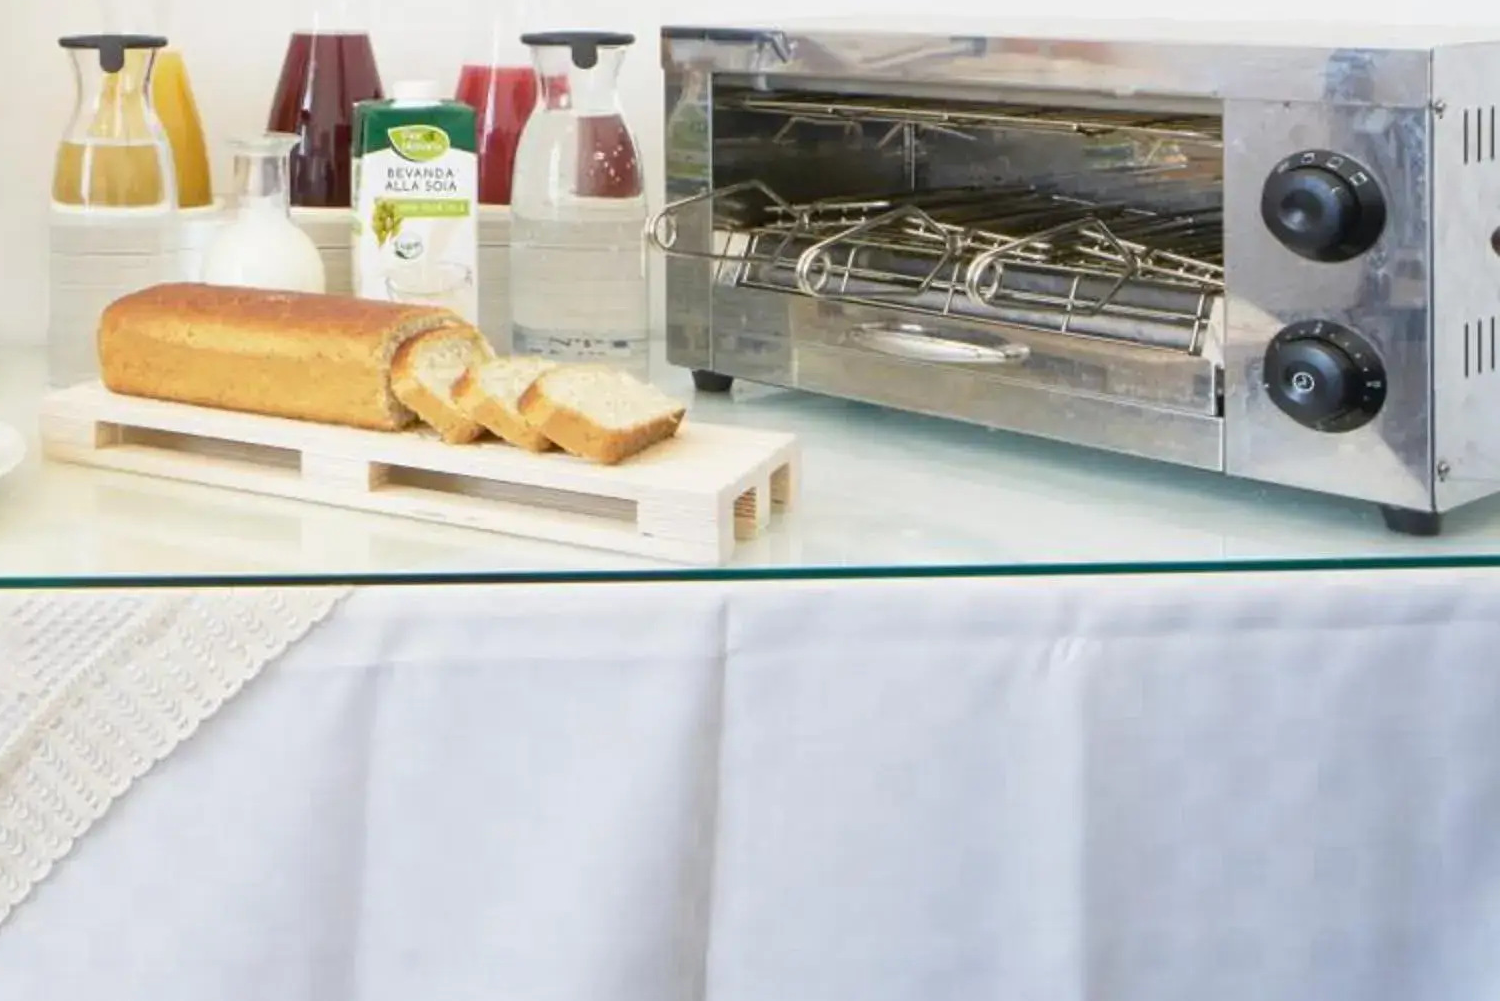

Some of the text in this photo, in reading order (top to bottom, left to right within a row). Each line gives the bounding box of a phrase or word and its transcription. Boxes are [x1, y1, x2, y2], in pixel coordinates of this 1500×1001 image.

[387, 167, 455, 179] BEVANDA
[385, 179, 457, 192] ALLA SOIA
